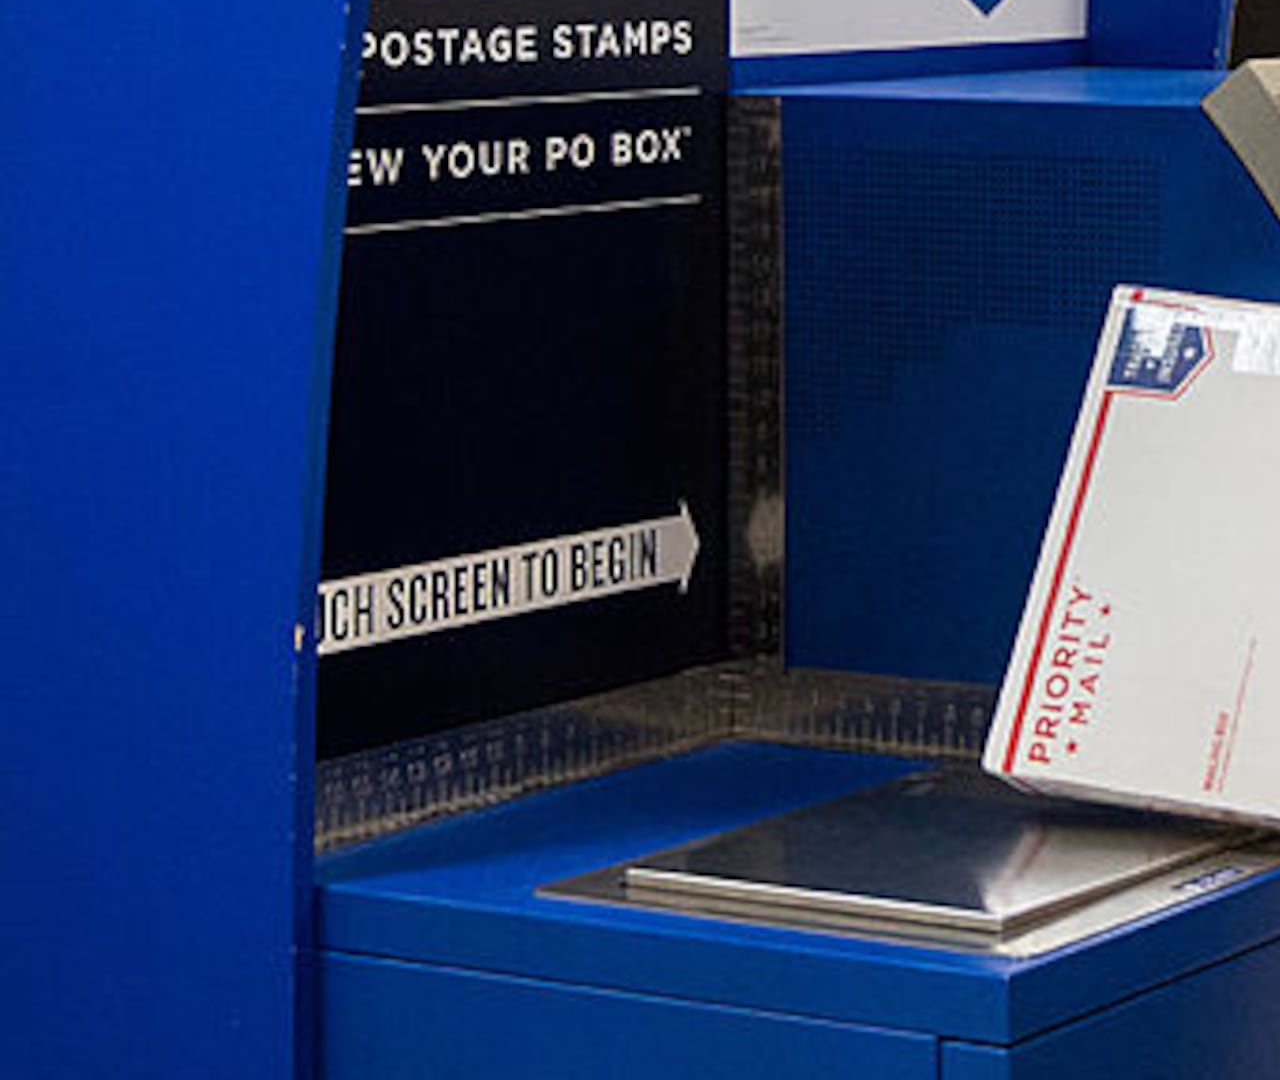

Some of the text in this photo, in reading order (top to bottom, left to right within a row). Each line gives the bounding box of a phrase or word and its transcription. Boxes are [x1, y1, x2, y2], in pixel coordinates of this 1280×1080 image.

[553, 20, 693, 59] STAMPS
[422, 140, 531, 179] YOUR
[546, 133, 596, 171] PO
[386, 557, 511, 630] SCREEN
[522, 548, 559, 602] TO
[571, 529, 657, 592] BEGIN
[1028, 585, 1094, 765] PRIORITY
[1069, 633, 1112, 725] MAIL
